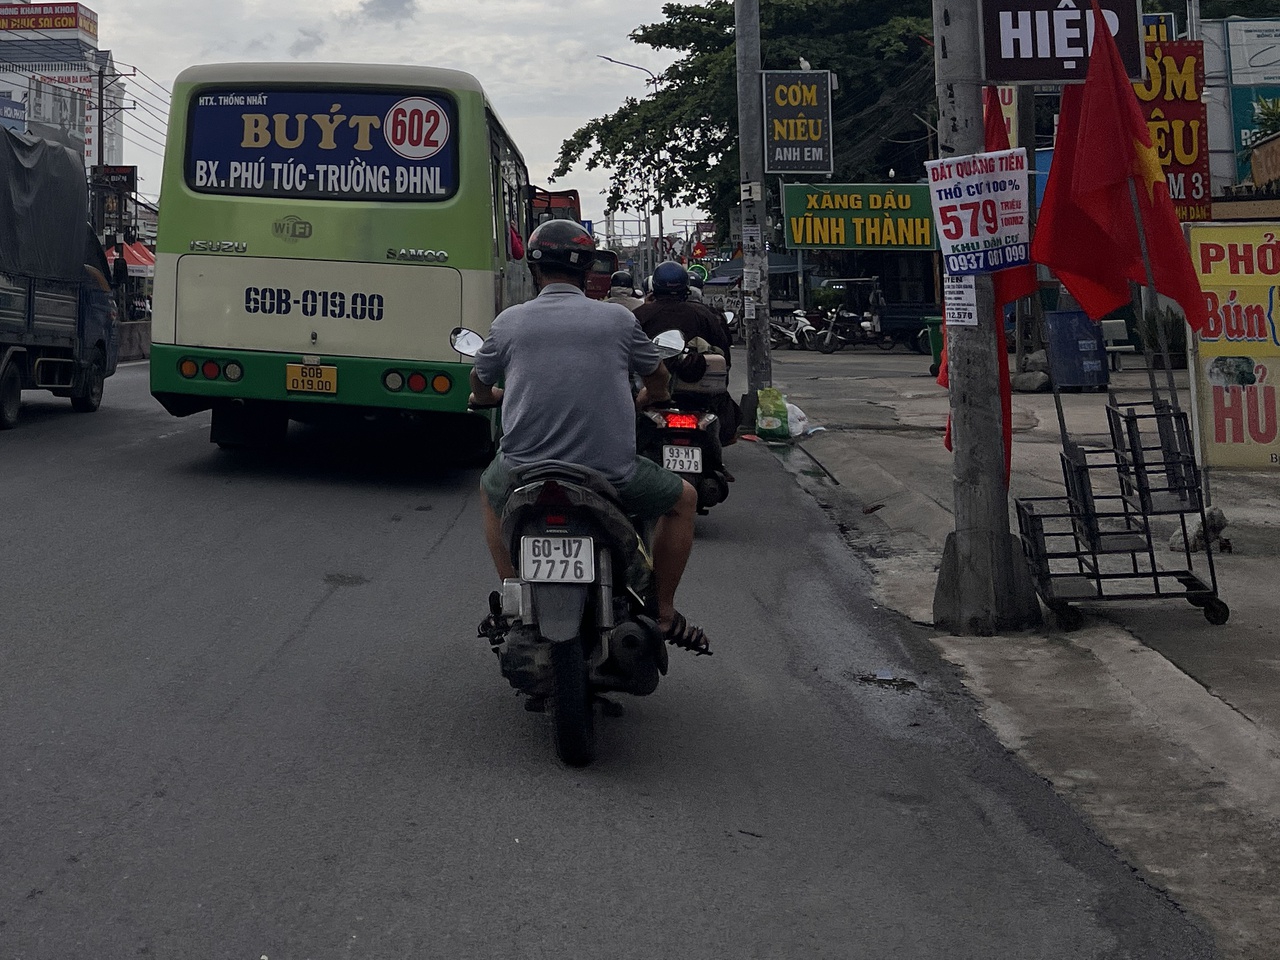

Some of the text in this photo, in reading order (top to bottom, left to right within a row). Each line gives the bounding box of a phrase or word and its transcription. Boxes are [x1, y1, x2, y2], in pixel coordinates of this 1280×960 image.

[55, 6, 75, 14] KHOA
[1133, 46, 1199, 101] ƠM
[775, 80, 818, 107] CƠM
[240, 103, 380, 151] BUÝT
[391, 108, 440, 147] 602
[773, 112, 823, 141] NIÊU
[1146, 107, 1200, 166] ÊU
[775, 147, 823, 161] ANH EM
[195, 156, 446, 195] BX. PHÚ TÚC-TRƯỜNG ĐHNL
[806, 189, 912, 209] XĂNG DẦU
[790, 212, 845, 244] VĨNH
[852, 212, 930, 245] THÀNH
[939, 199, 999, 240] 579
[190, 240, 247, 253] ISUZU
[386, 247, 448, 263] SAMCO
[949, 252, 985, 272] 0937
[1005, 244, 1026, 262] 099
[951, 242, 979, 253] KHU
[1199, 232, 1280, 275] PHỞ
[244, 287, 384, 321] 60B-019.00
[1200, 289, 1268, 342] Bún
[291, 379, 331, 391] 019.00
[301, 367, 322, 379] 60B
[1213, 364, 1278, 444] HỦ
[532, 539, 583, 558] 60-U7
[532, 559, 584, 579] 7776
